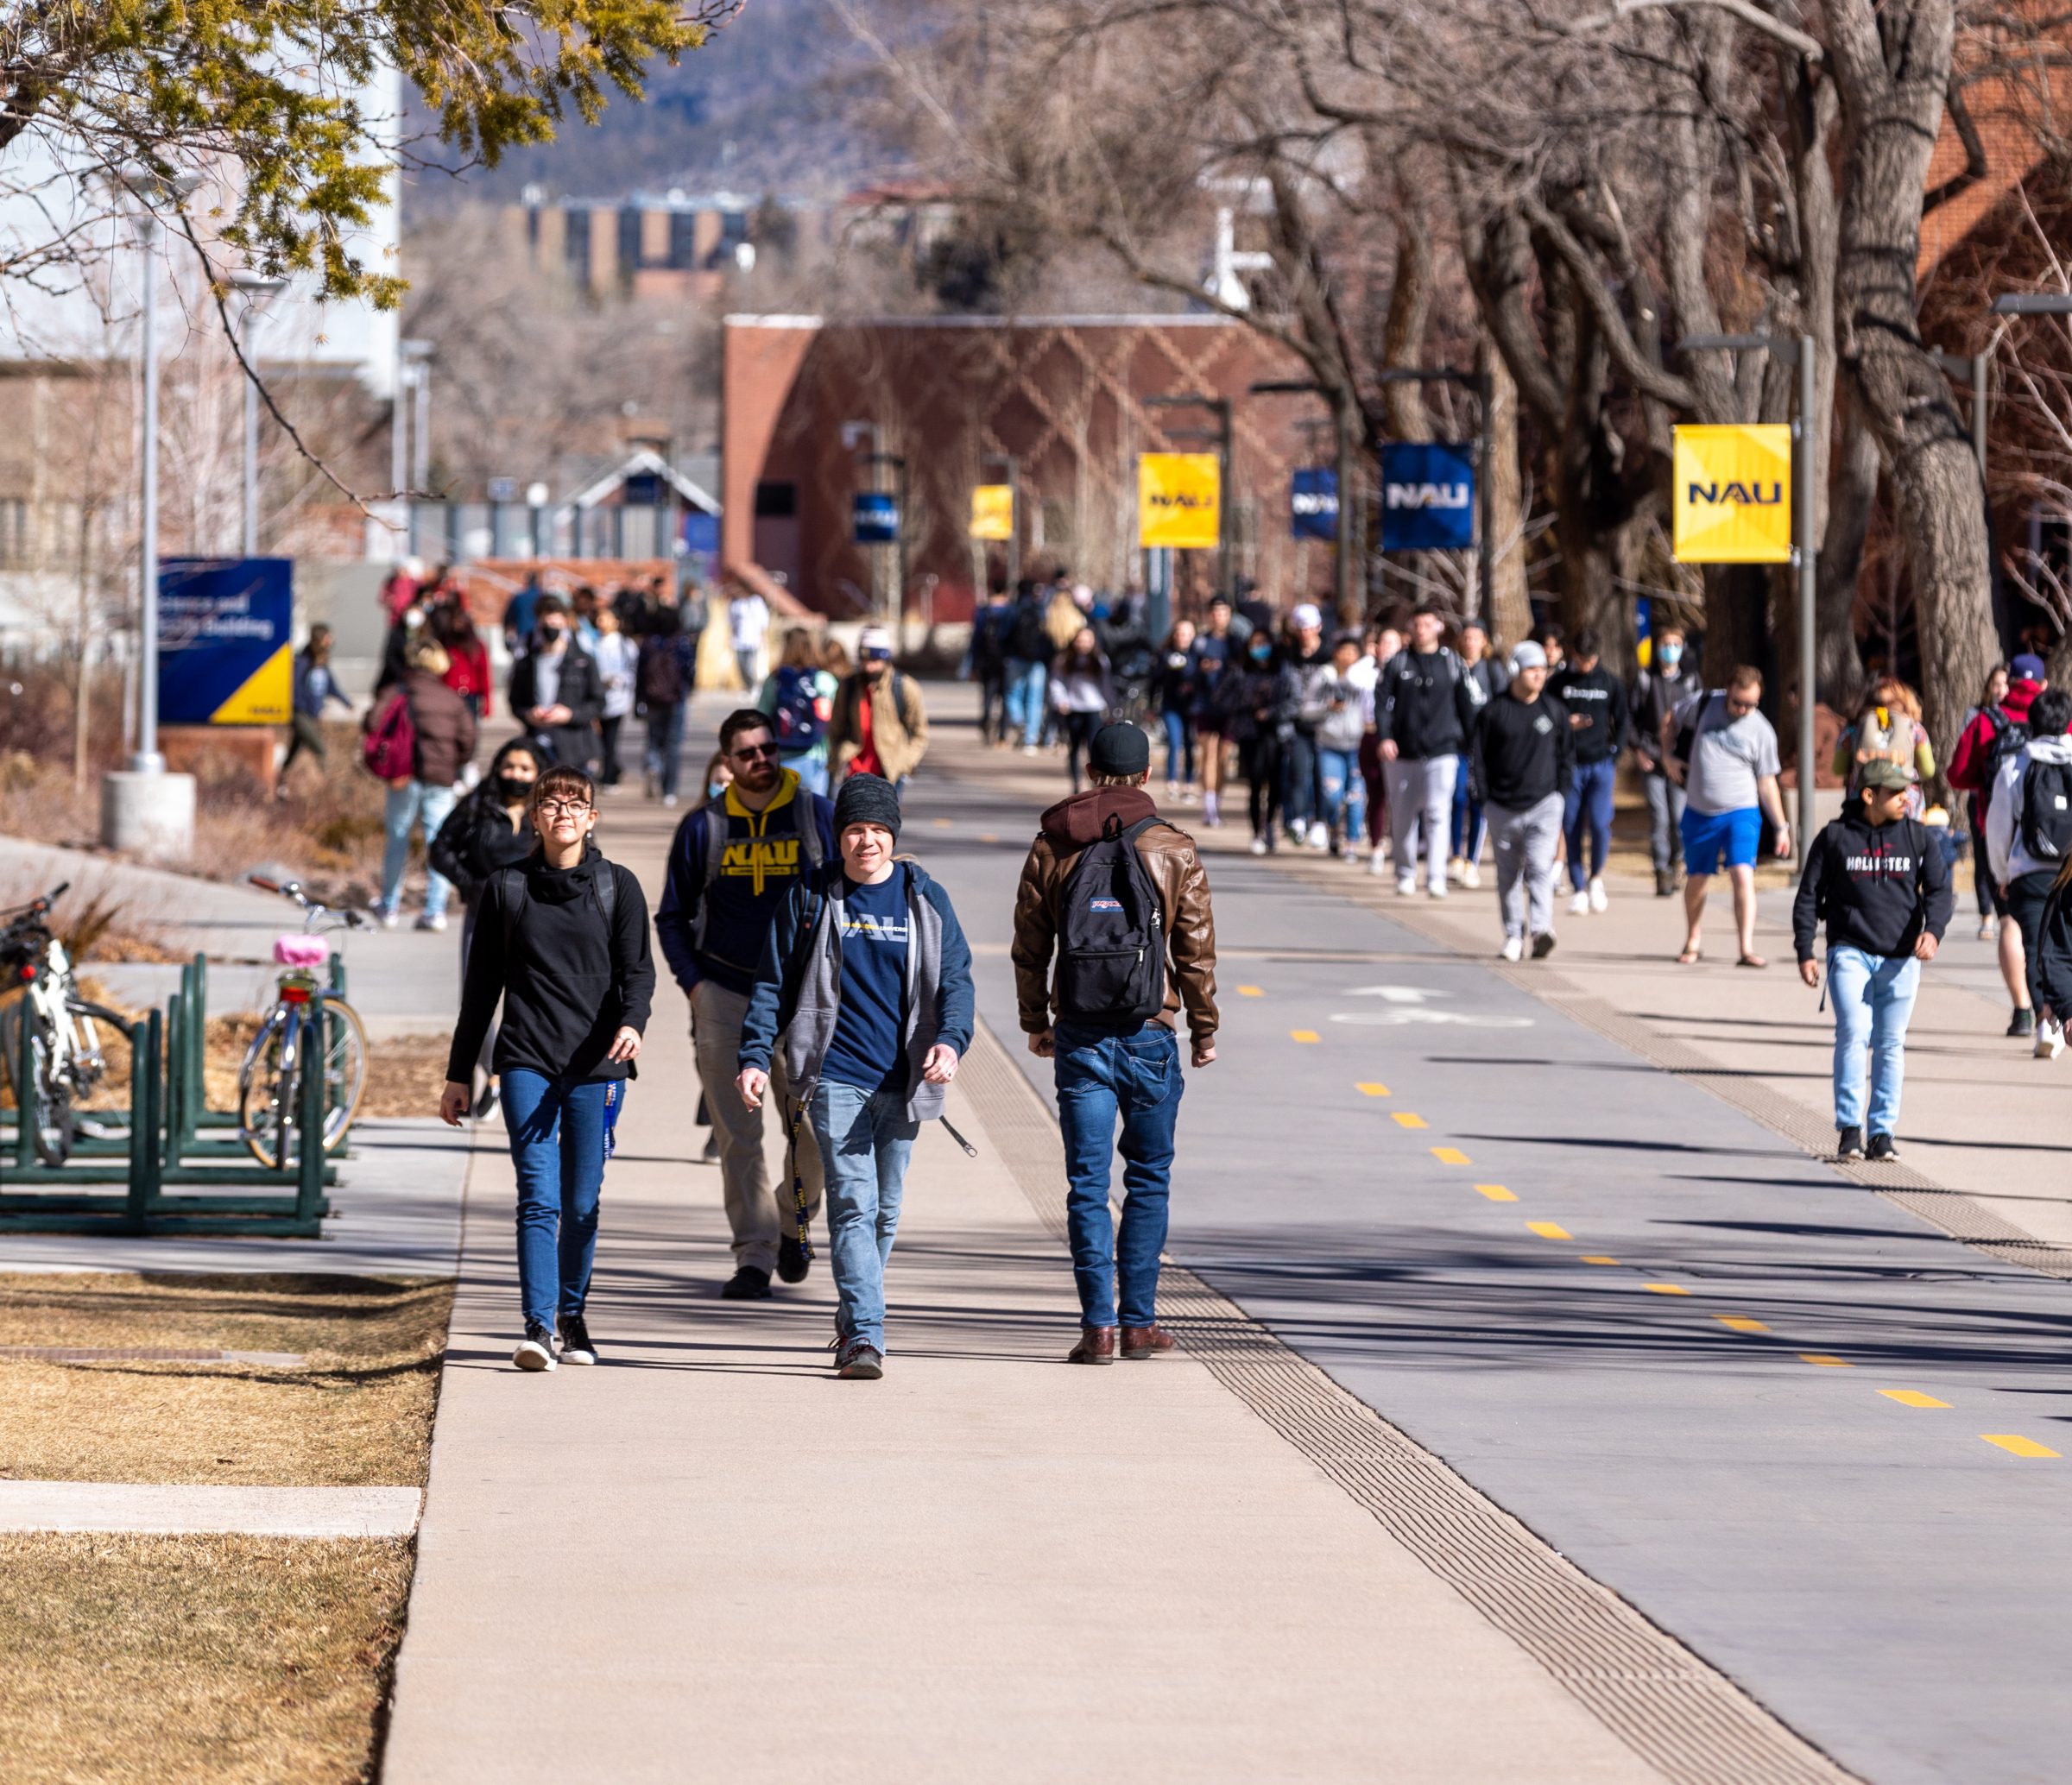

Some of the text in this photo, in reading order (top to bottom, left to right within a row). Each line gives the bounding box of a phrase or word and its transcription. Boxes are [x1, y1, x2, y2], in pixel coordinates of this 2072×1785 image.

[1387, 483, 1469, 509] NAU
[1689, 483, 1781, 504] NAU
[721, 840, 799, 865] NAU
[842, 912, 908, 943] AU
